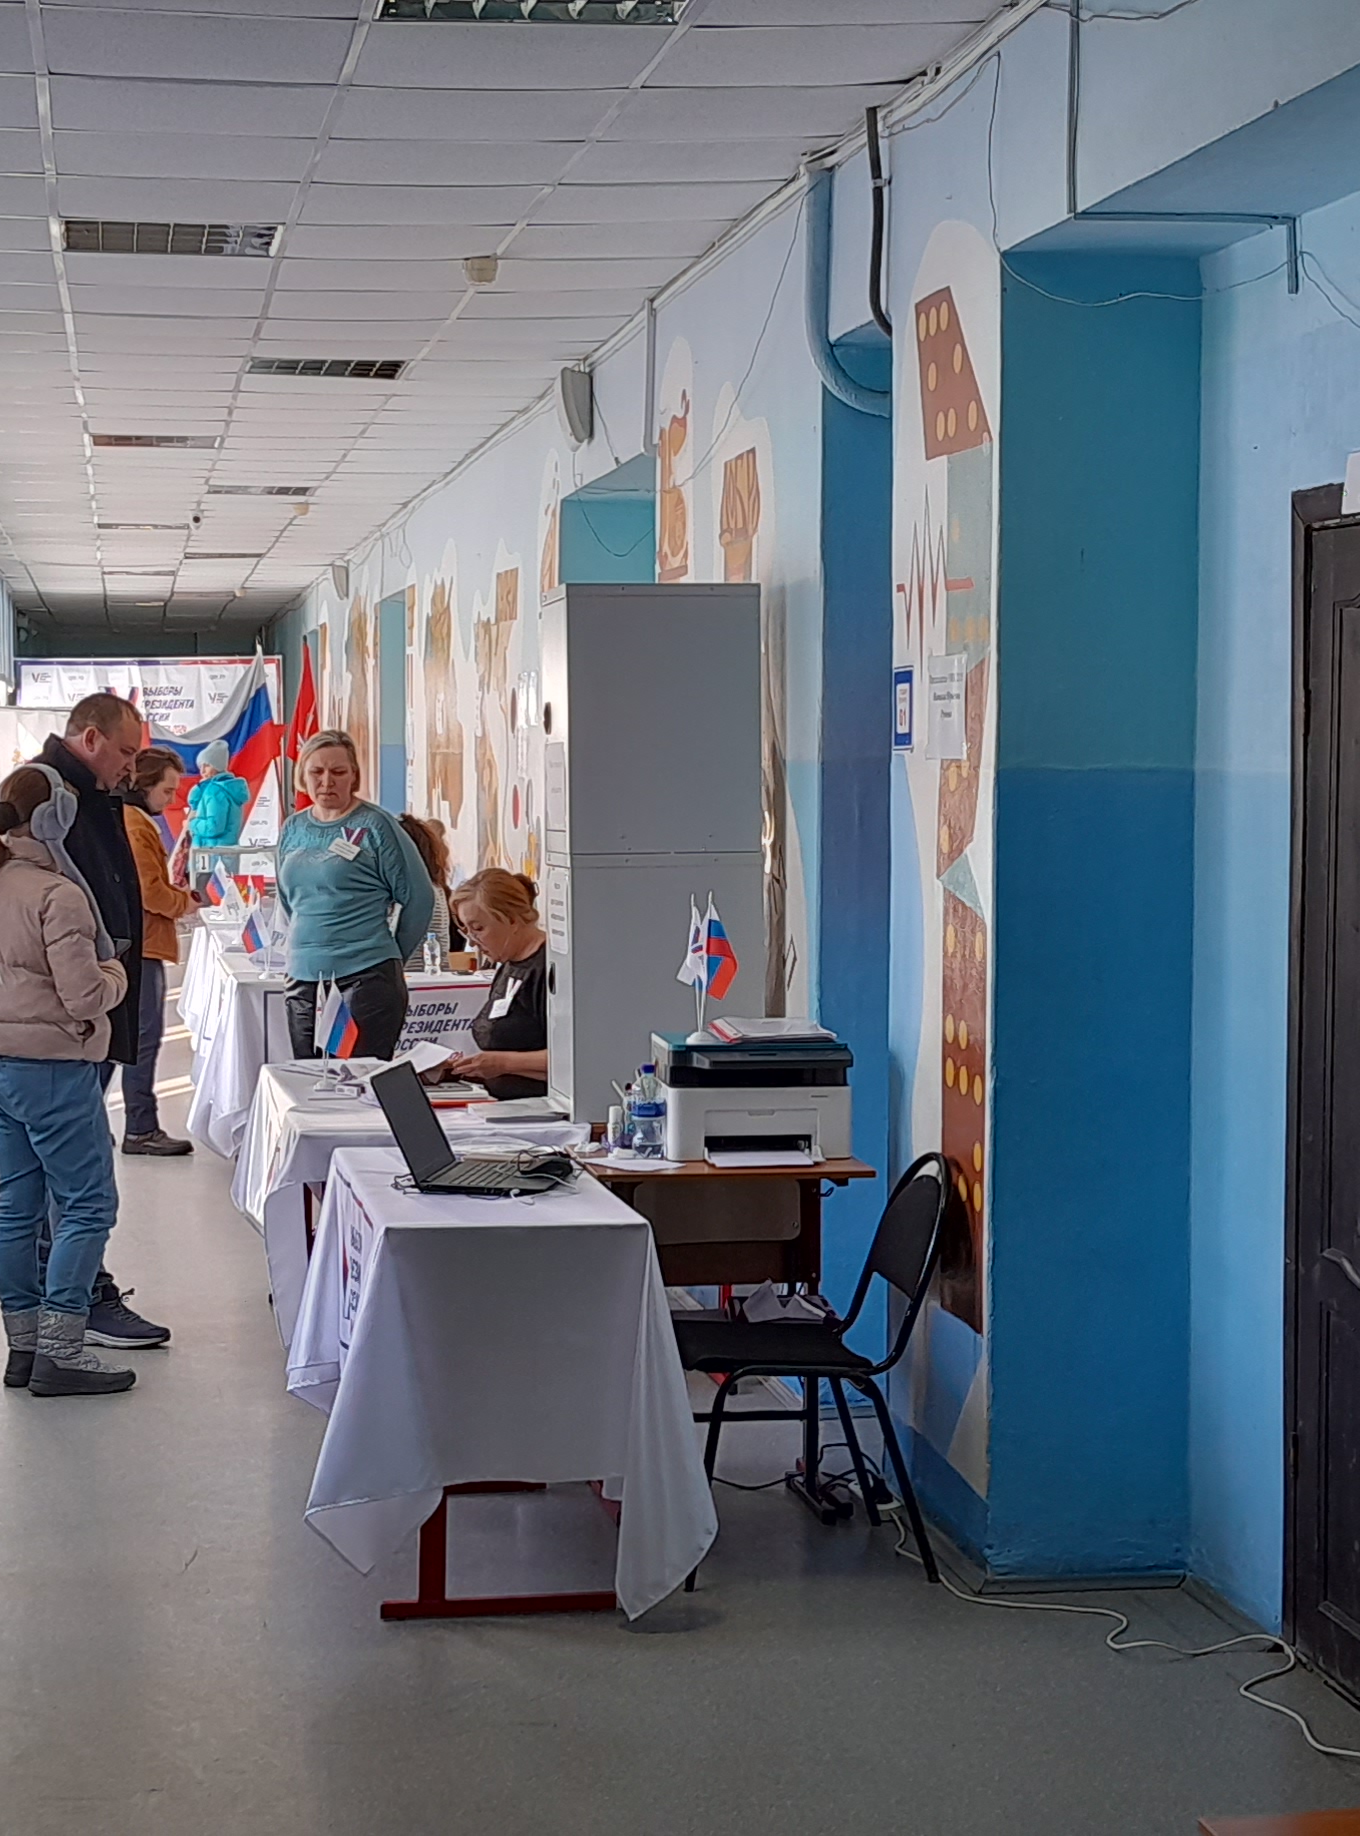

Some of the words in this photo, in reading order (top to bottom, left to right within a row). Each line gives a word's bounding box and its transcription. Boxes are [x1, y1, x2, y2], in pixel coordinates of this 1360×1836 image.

[143, 686, 183, 697] ВЫБОРЫ
[142, 698, 195, 711] РЕЗИДЕНТА
[201, 855, 207, 870] 1
[405, 1002, 458, 1017] ЫБОРЫ
[400, 1018, 475, 1034] РЕЗИДЕНТА
